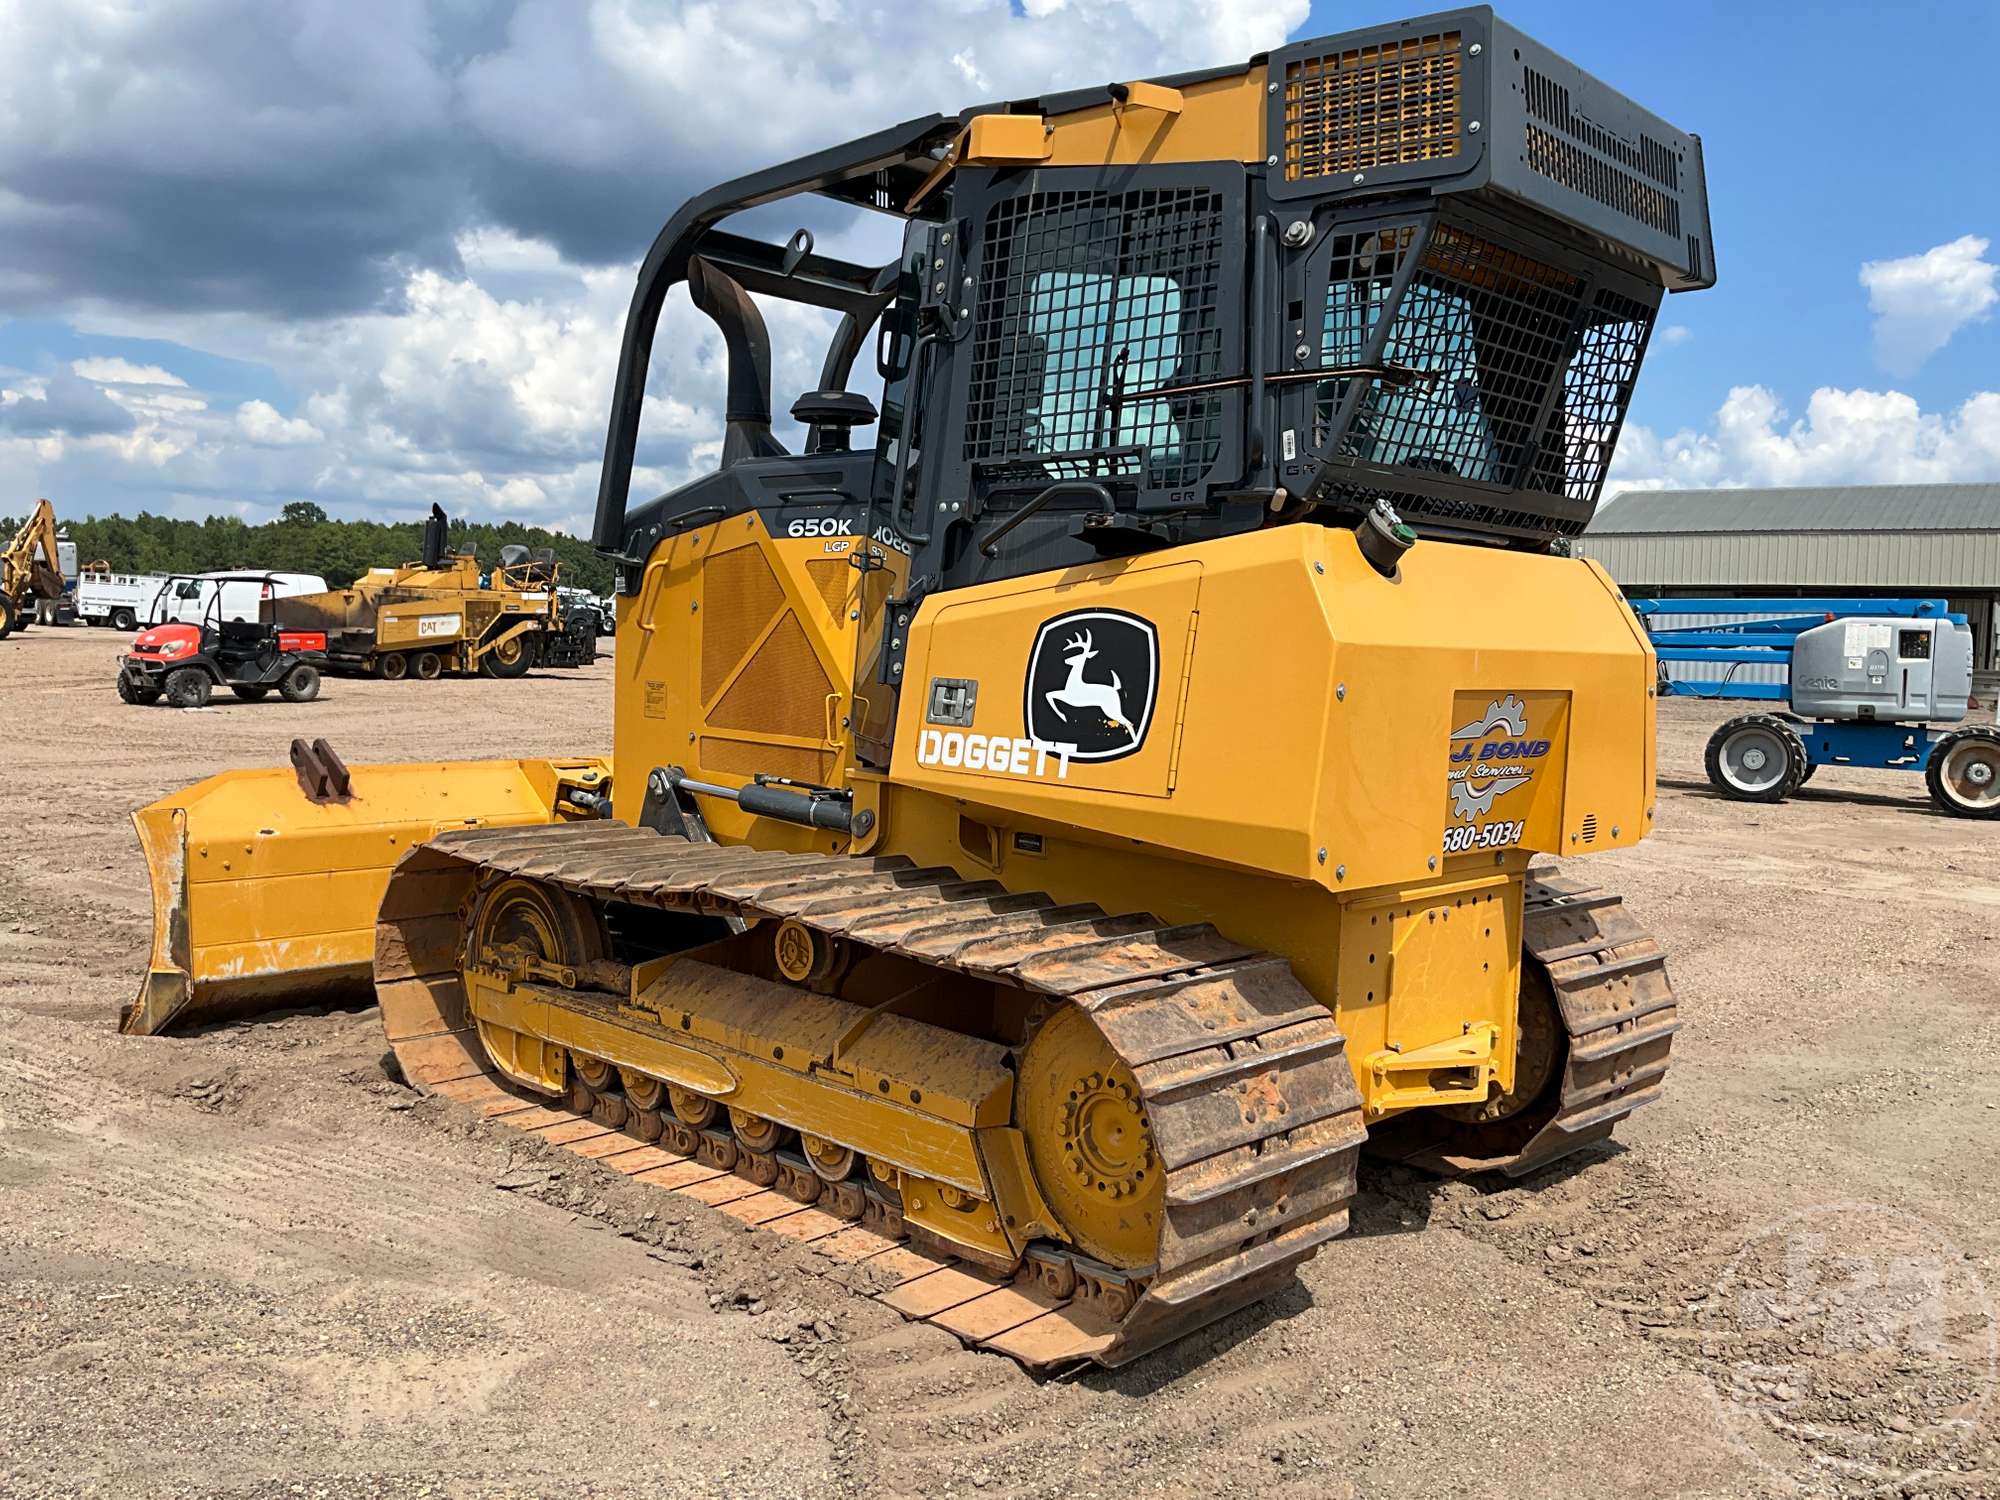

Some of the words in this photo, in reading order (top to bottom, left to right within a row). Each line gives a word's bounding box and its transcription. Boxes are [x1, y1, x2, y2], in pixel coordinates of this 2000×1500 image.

[788, 518, 853, 537] 650K
[824, 541, 850, 553] LGP
[421, 621, 438, 634] CAT
[917, 729, 1078, 779] DOGGETT
[1478, 739, 1552, 760] BOND
[1471, 763, 1524, 778] Services
